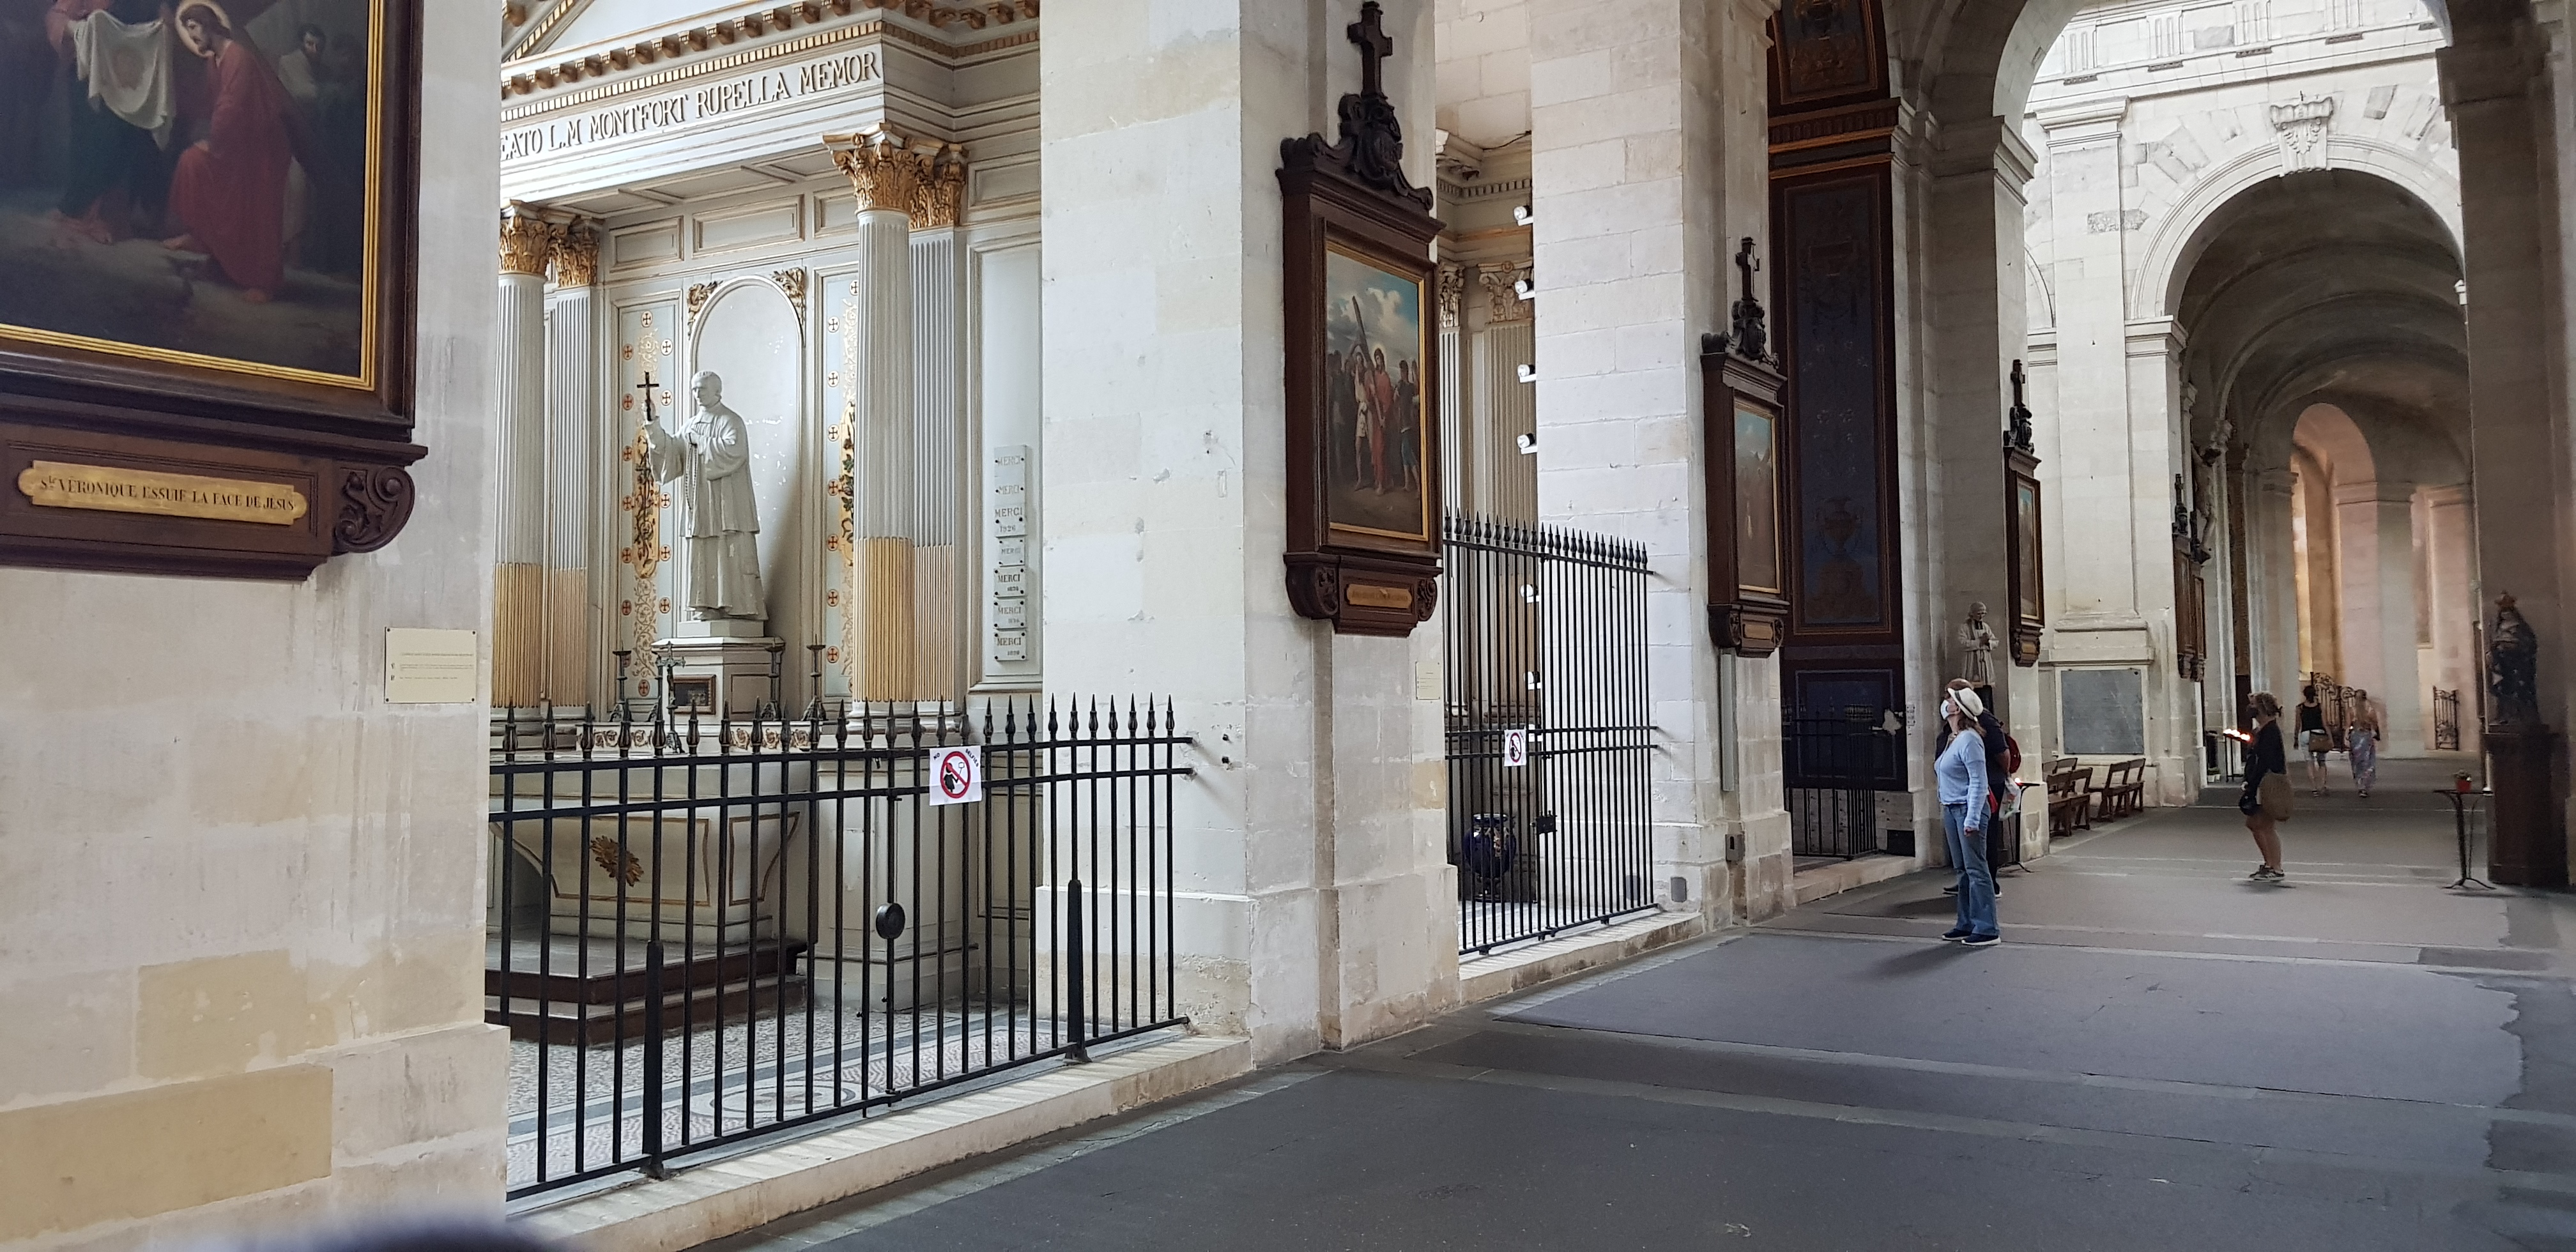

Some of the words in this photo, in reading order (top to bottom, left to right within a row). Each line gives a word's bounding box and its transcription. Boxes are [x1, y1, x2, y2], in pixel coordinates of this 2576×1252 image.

[588, 93, 689, 142] MONTFORT
[695, 72, 791, 118] RUPELLA
[798, 51, 880, 96] MEMOR
[997, 455, 1020, 466] MERCI
[998, 484, 1019, 494] MERCI
[142, 485, 186, 502] ESSUIE
[192, 490, 208, 504] LA
[213, 492, 241, 507] FACE
[246, 495, 261, 508] DE
[995, 507, 1022, 517] MERCI
[998, 574, 1020, 583] MERCI
[997, 637, 1021, 646] MERCI
[965, 749, 979, 767] SELFIES
